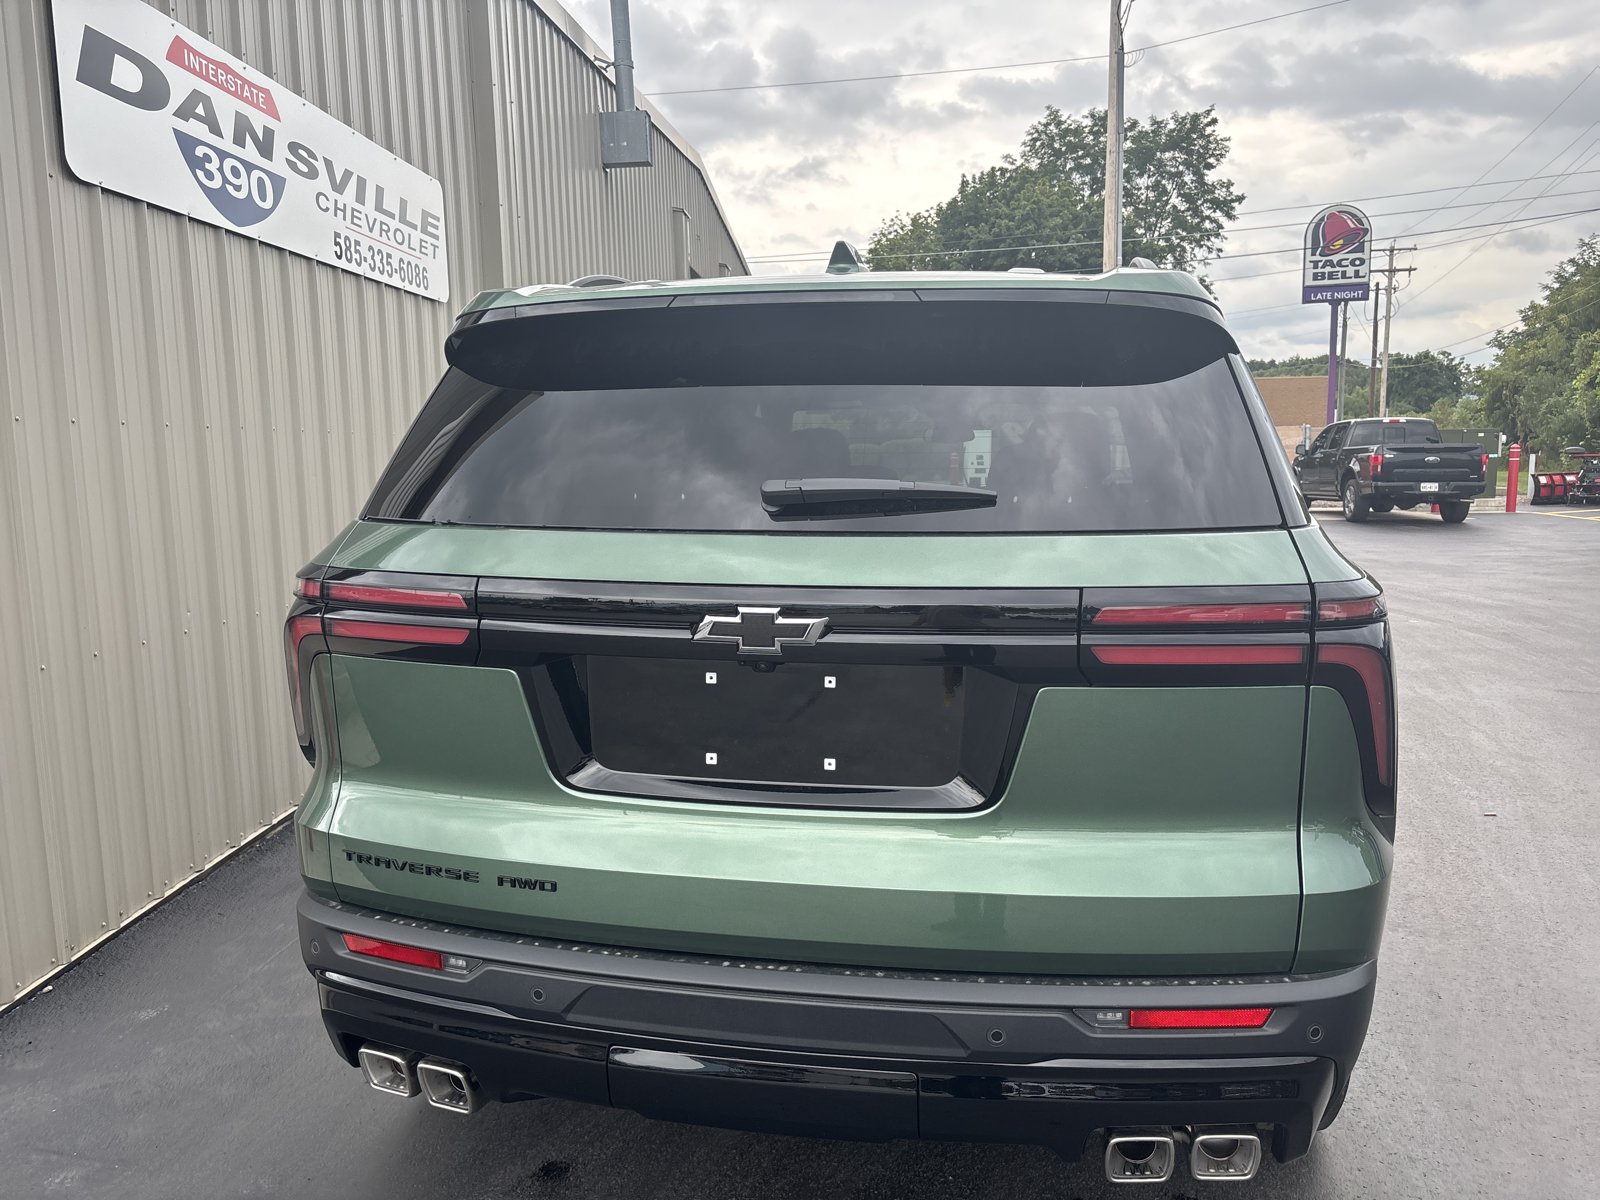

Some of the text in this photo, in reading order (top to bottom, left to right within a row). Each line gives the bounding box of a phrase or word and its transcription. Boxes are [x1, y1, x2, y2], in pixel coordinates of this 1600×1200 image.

[183, 48, 267, 109] INTERSTATE
[75, 24, 440, 241] DANSVILLE
[193, 145, 274, 210] 390
[315, 191, 439, 260] CHEVROLET
[333, 230, 429, 291] 585-335-6086
[1309, 258, 1366, 269] TACO
[1313, 270, 1367, 281] BELL
[1334, 291, 1363, 299] NIGHT
[343, 849, 558, 893] TRAVERSE AWD
